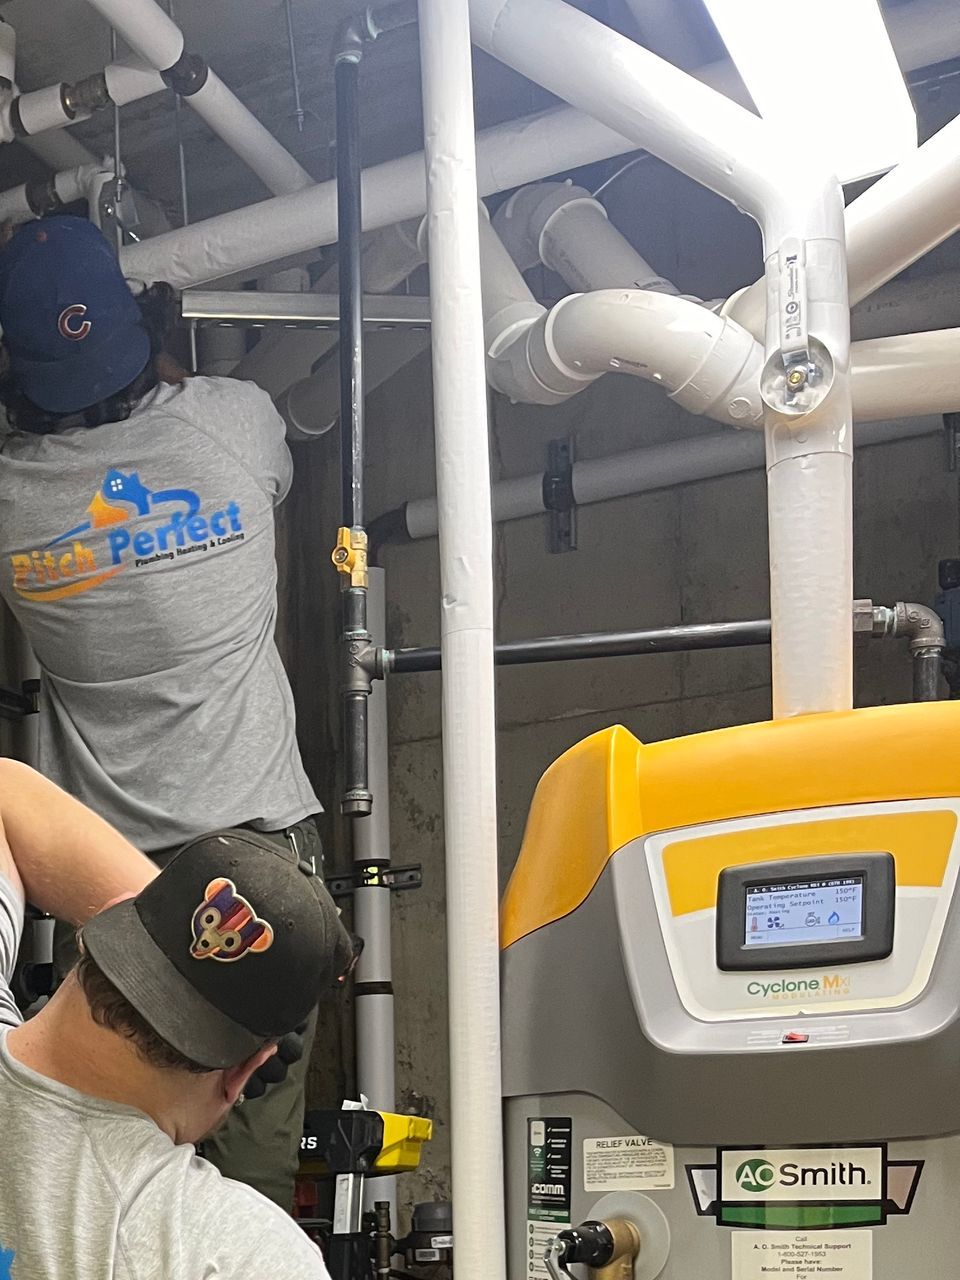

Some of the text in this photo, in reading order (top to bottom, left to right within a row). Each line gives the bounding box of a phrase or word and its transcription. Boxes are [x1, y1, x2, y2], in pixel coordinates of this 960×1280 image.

[58, 304, 91, 340] C
[11, 501, 243, 587] Pitch Perfect
[135, 531, 245, 568] Plumbing Heating & Cooling
[747, 901, 786, 911] Operating
[789, 898, 824, 908] Setpoint
[748, 893, 764, 902] Tank
[769, 891, 816, 902] Temperature
[747, 979, 820, 998] Cyclone
[596, 1137, 653, 1149] RELIEF VALVE
[779, 1161, 866, 1187] Smith
